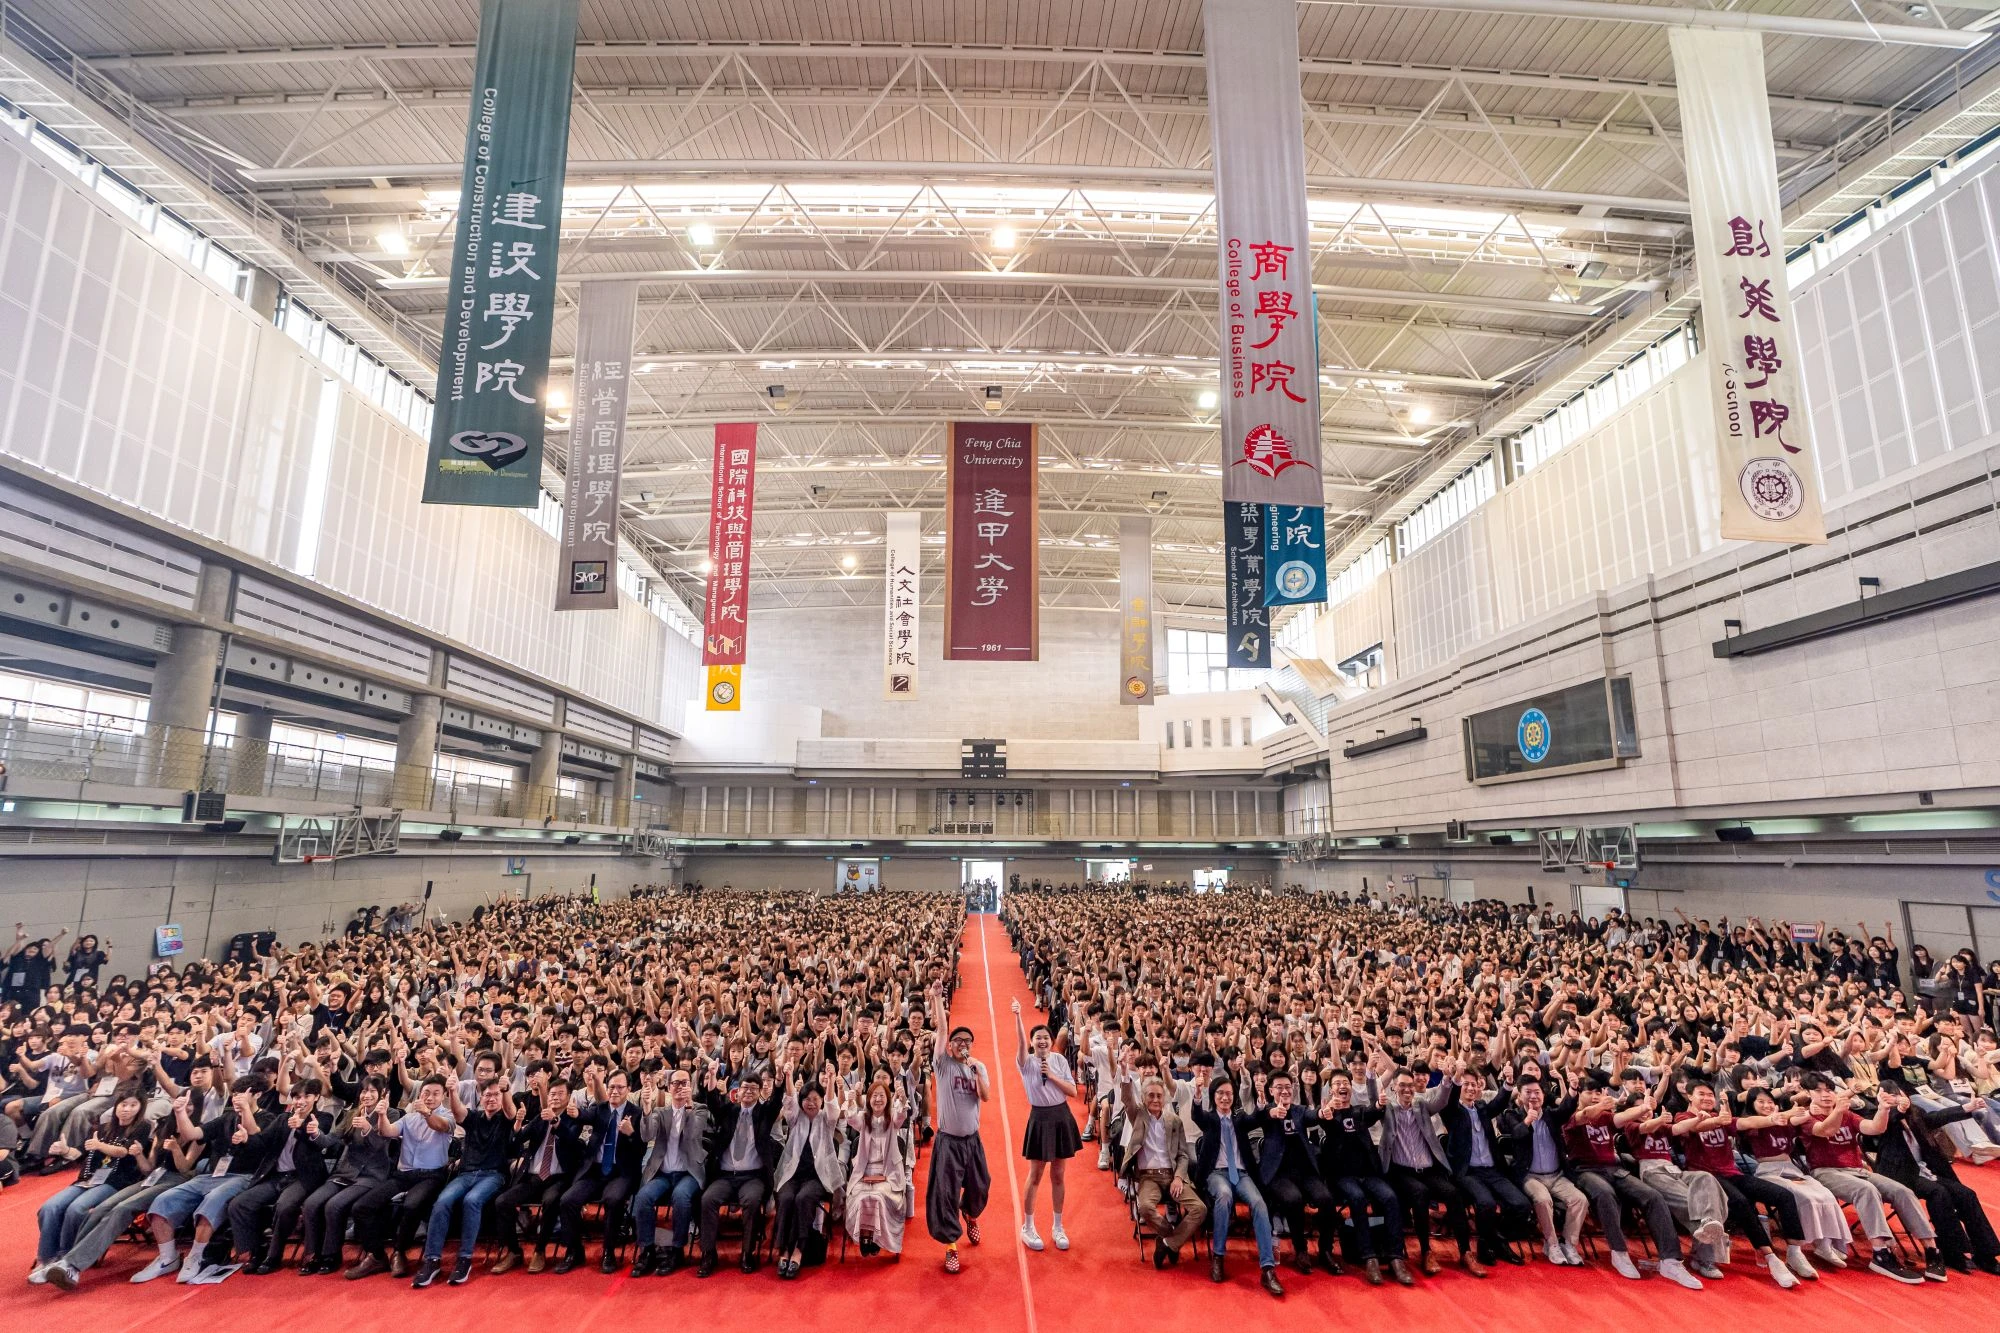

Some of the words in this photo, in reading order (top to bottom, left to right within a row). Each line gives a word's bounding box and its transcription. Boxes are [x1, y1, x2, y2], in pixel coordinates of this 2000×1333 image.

[477, 88, 497, 141] College
[478, 146, 491, 160] of
[466, 165, 488, 261] Construction
[463, 266, 476, 294] and
[1227, 239, 1242, 297] College
[475, 192, 546, 404] 建設學院
[1231, 303, 1244, 319] of
[1249, 240, 1307, 403] 商學院
[451, 299, 474, 401] Development
[1231, 325, 1244, 399] Business
[578, 401, 586, 411] of
[579, 363, 589, 398] School
[573, 413, 586, 477] Management
[583, 360, 624, 546] 經營管理學院
[963, 454, 1023, 469] University
[965, 437, 993, 450] Feng
[996, 437, 1022, 449] Chia
[567, 480, 580, 547] Development
[716, 486, 724, 509] School
[721, 449, 749, 623] 國際科技與管理學院
[970, 487, 1015, 607] 逢甲大學
[1270, 503, 1280, 551] gineering
[896, 566, 915, 665] 人文社會學院
[1231, 581, 1239, 626] Architecture
[980, 644, 1001, 652] 1961
